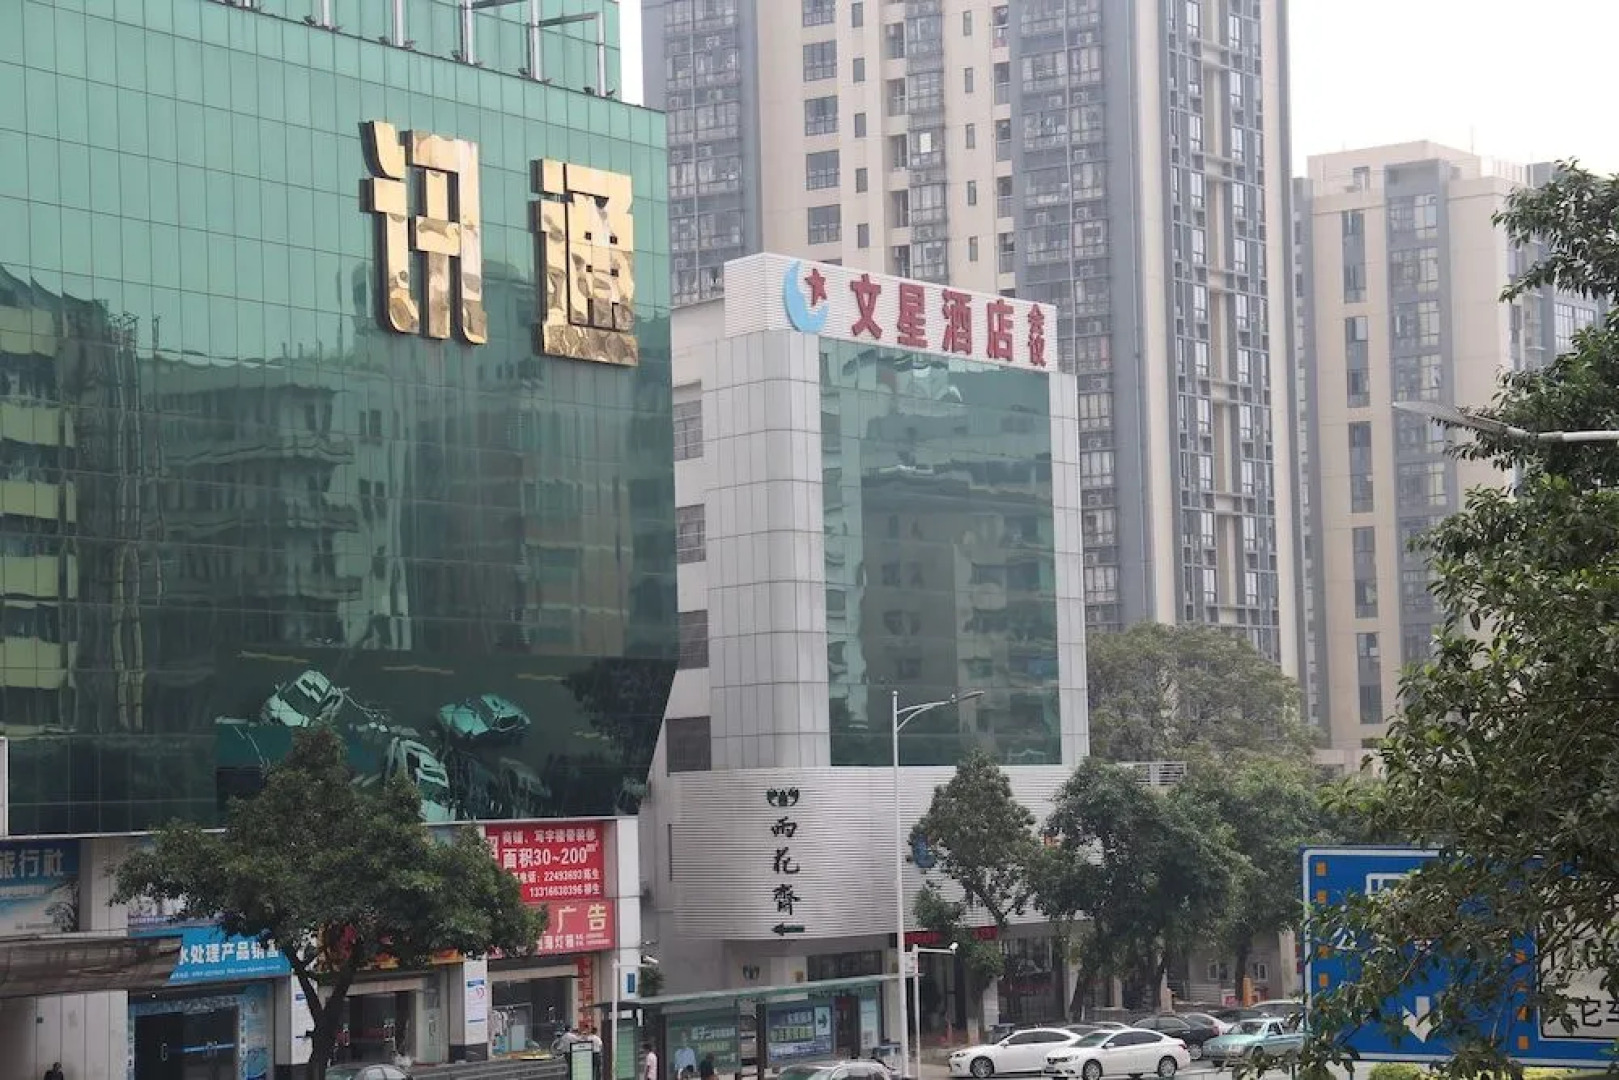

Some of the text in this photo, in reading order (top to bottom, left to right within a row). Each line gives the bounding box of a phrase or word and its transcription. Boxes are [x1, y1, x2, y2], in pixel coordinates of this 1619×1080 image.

[850, 273, 1014, 362] 文星酒店
[557, 903, 608, 933] 广告
